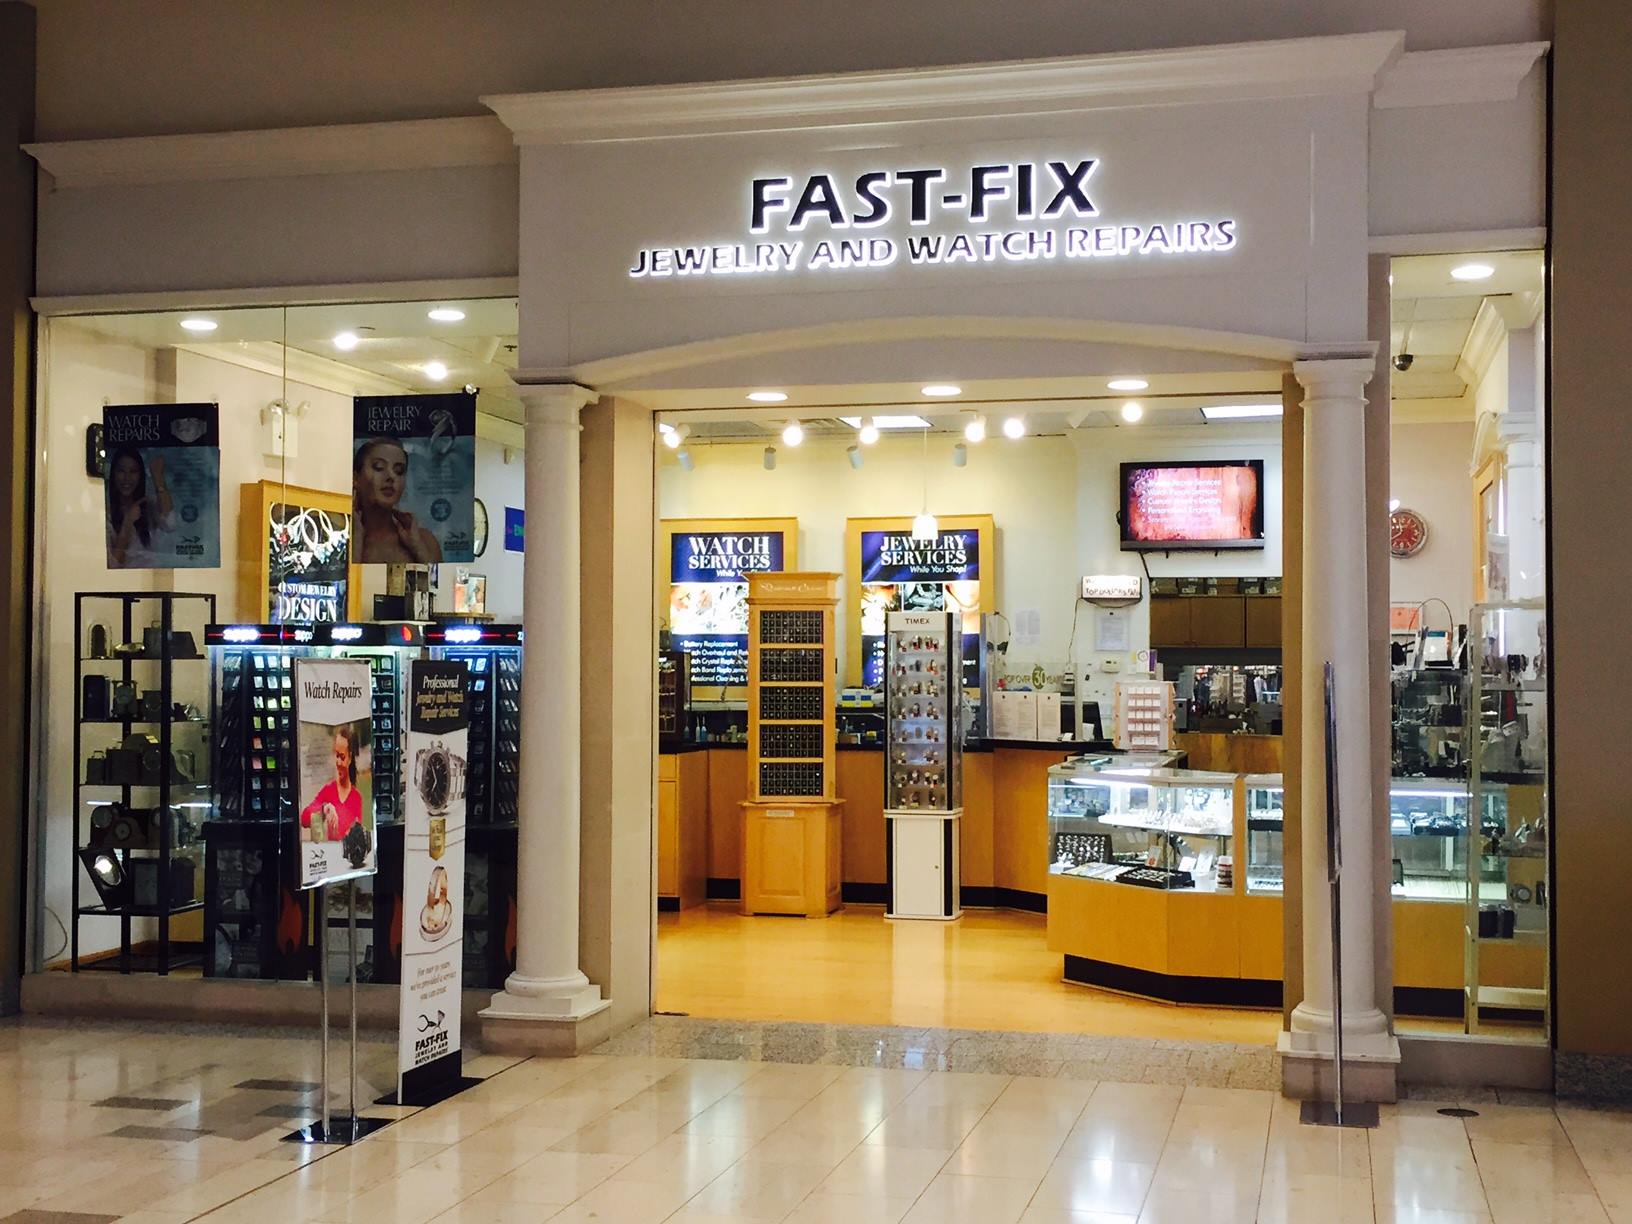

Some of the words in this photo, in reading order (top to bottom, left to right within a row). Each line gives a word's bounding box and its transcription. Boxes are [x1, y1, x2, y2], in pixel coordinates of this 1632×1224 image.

[751, 159, 1100, 234] FAST-FIX
[630, 241, 803, 276] JEWELRY
[807, 237, 898, 266] AND
[907, 229, 1055, 265] WATCH
[1065, 220, 1236, 256] REPAIRS
[368, 405, 423, 419] JEWELRY
[109, 414, 160, 429] WATCH
[368, 419, 411, 432] REPAIR
[109, 428, 160, 442] REPAIRS
[688, 536, 770, 555] WATCH
[880, 535, 968, 551] JEWELRY
[688, 555, 771, 569] SERVICES
[881, 550, 967, 566] SERVICES
[910, 566, 930, 574] While
[931, 565, 944, 573] You
[278, 596, 337, 623] DESIGN
[423, 674, 460, 691] Professional
[1034, 670, 1046, 686] 30
[304, 681, 331, 699] Watch
[333, 681, 362, 704] Repairs
[415, 1030, 448, 1052] FAST-FIX
